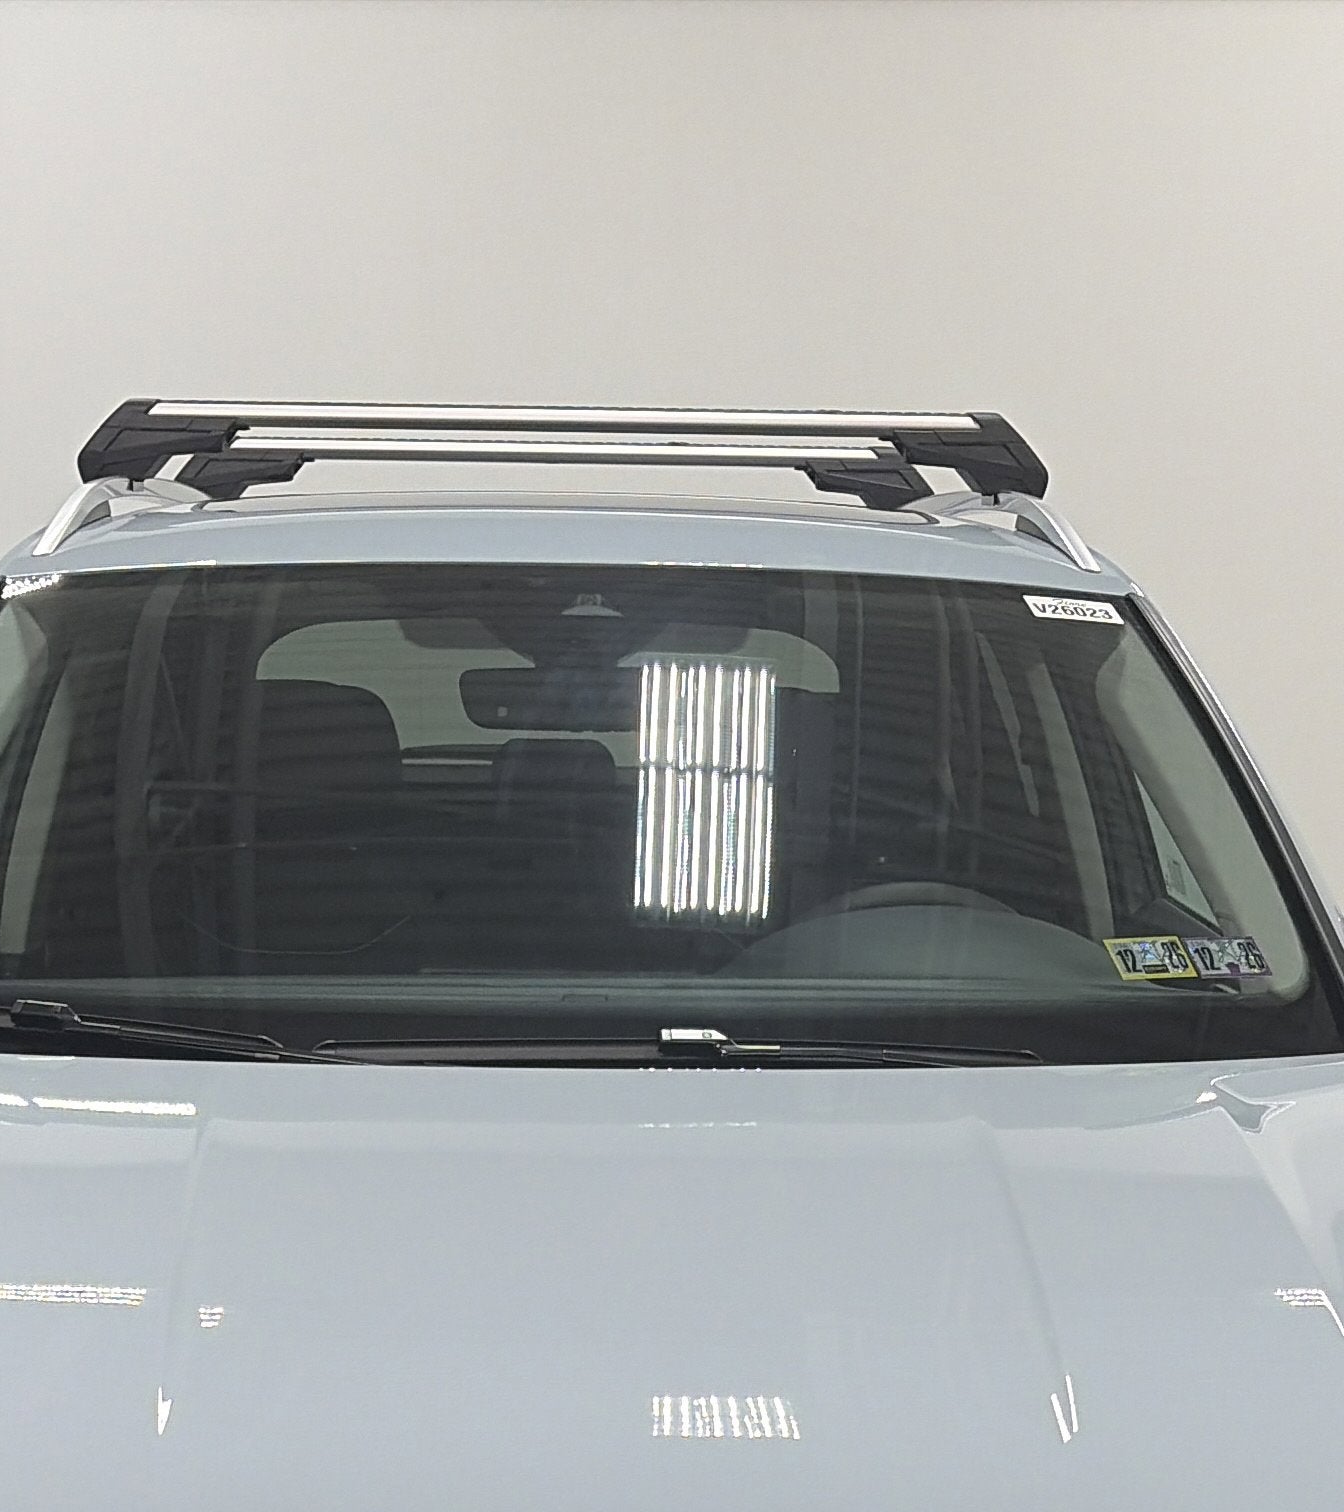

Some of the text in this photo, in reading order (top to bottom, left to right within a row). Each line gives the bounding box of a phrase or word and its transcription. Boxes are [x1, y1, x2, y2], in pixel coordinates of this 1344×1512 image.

[1033, 603, 1113, 619] V26023
[1116, 942, 1189, 973] 12 26
[1195, 942, 1265, 971] 12 26
